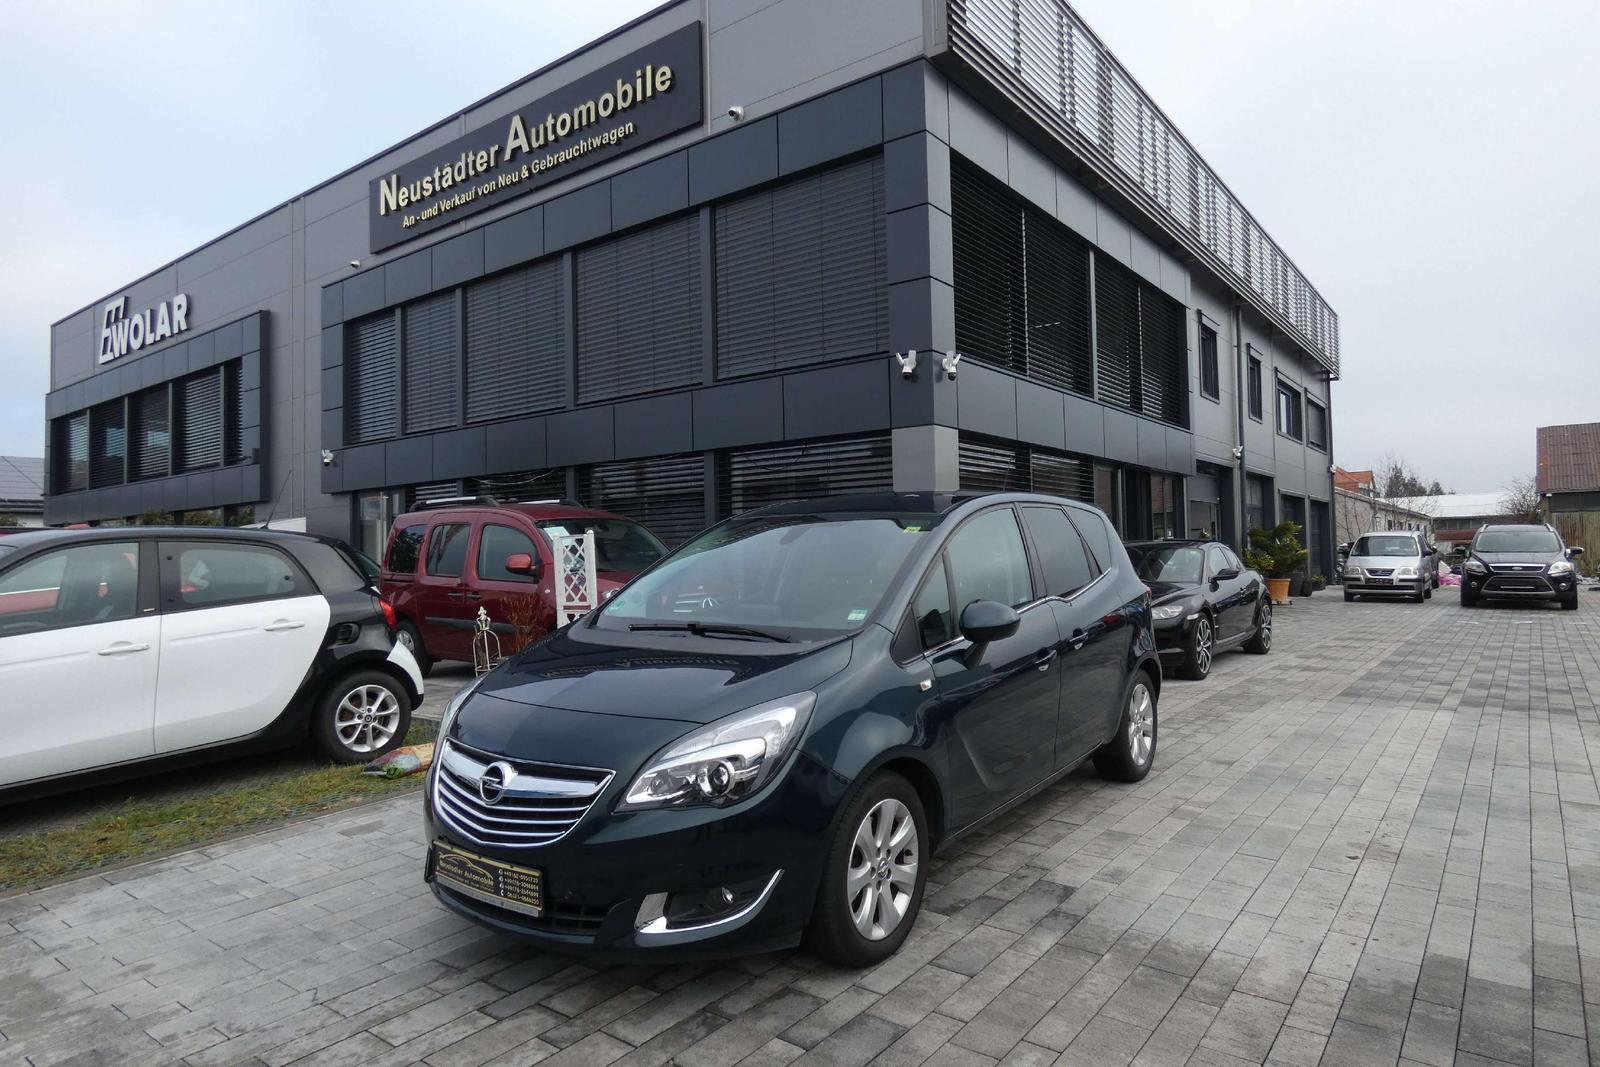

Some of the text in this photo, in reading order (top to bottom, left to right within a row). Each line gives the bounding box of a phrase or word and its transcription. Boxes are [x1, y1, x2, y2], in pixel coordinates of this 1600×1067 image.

[380, 65, 673, 215] Neustädter Automobile
[421, 206, 439, 222] und
[439, 186, 477, 213] Verkauf
[477, 179, 497, 197] von
[498, 172, 519, 189] Neu
[520, 164, 530, 178] &
[531, 121, 635, 174] Gebrauchtwagen
